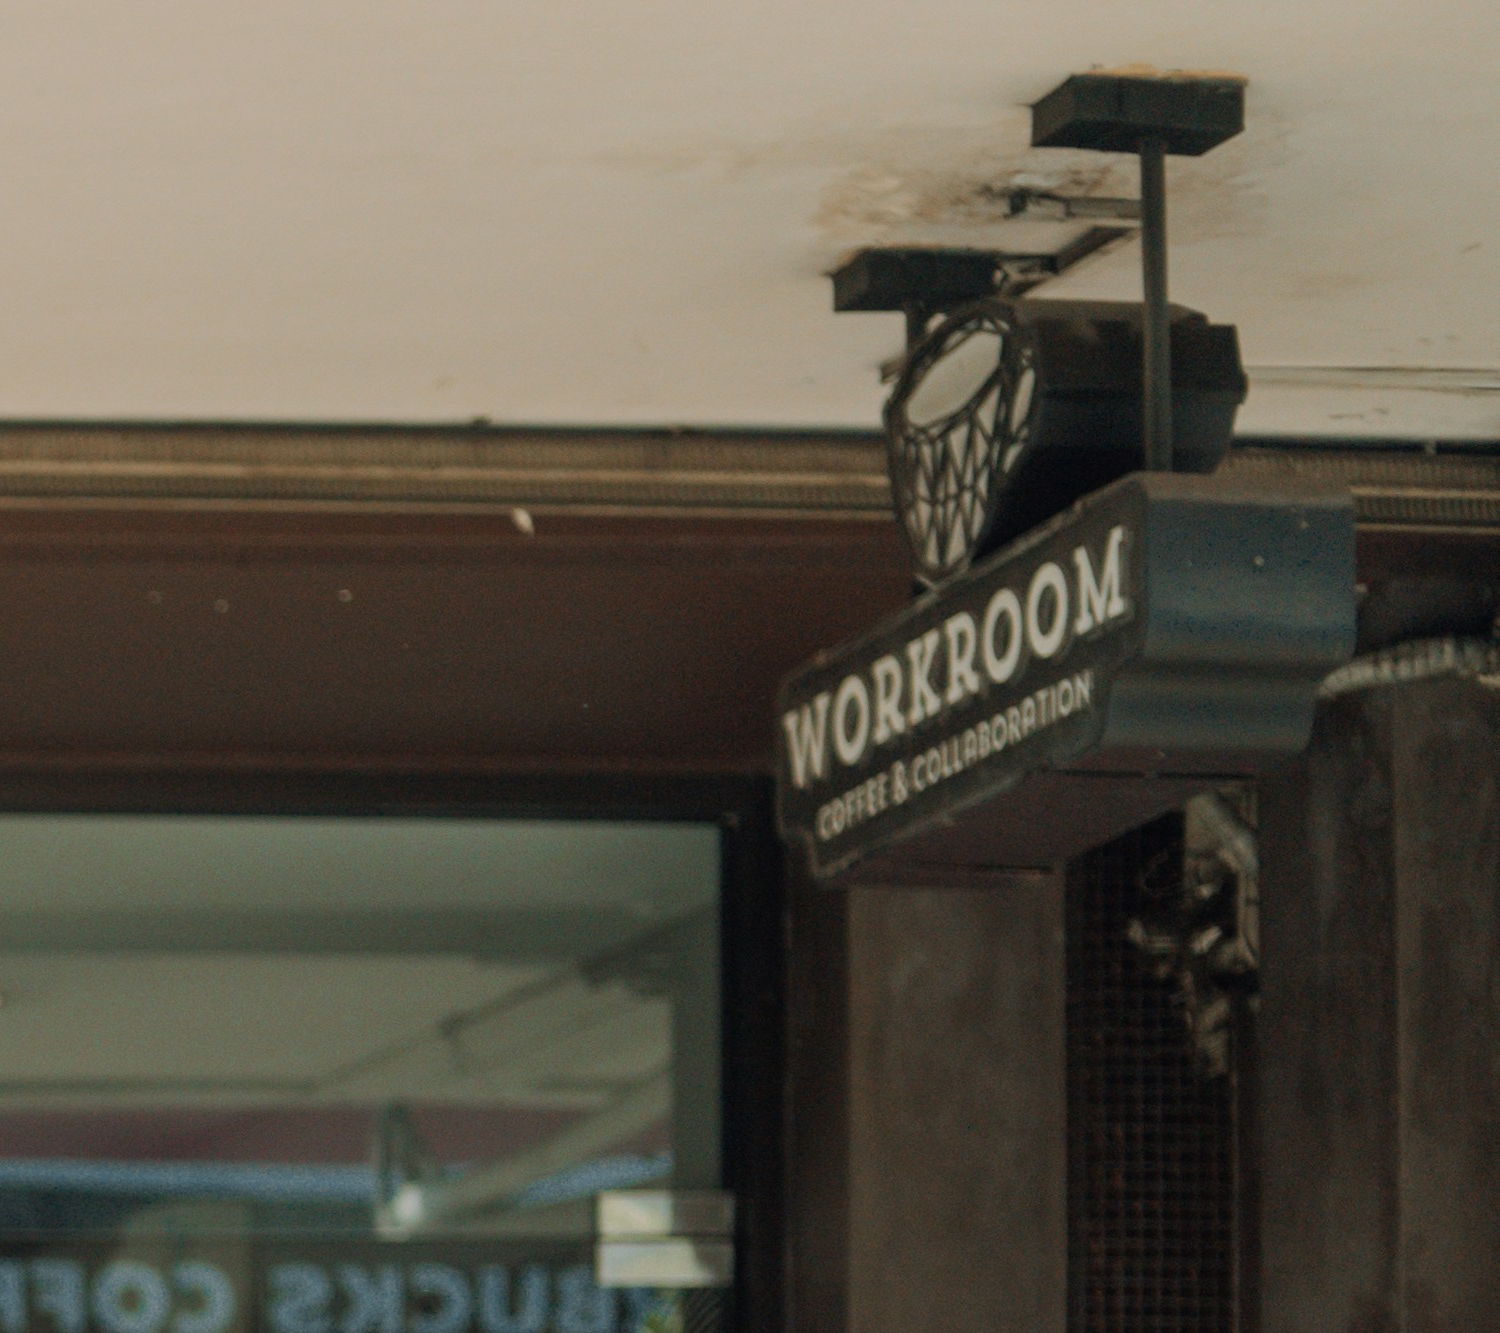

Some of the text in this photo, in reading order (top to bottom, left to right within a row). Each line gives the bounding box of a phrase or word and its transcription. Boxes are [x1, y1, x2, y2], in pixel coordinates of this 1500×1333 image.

[783, 525, 1126, 788] WORKROOM
[817, 668, 1095, 840] COFFEE & COLLABORATION
